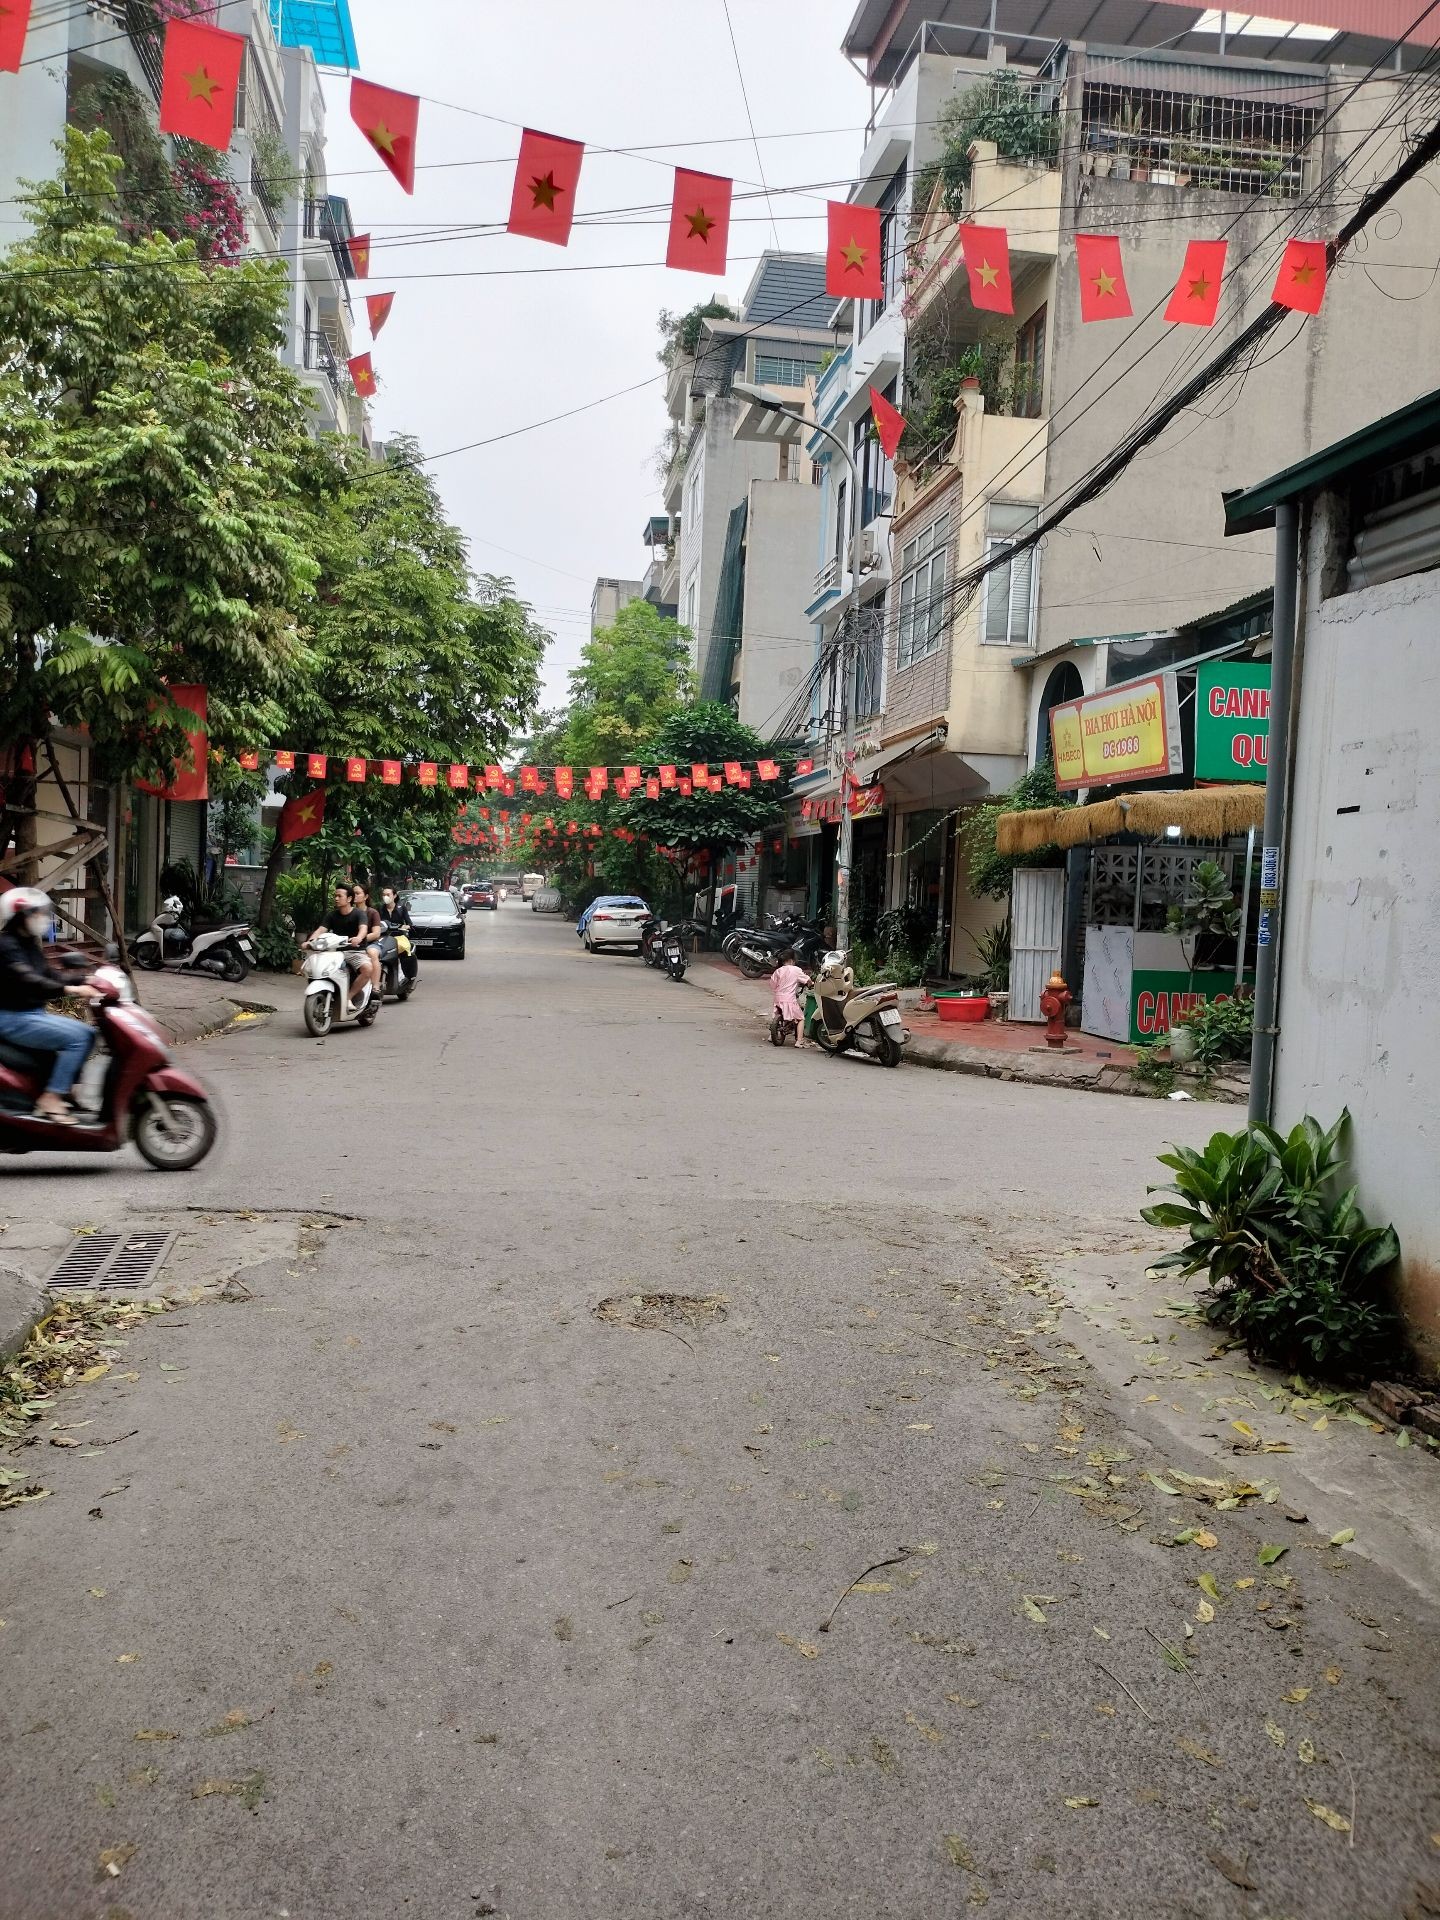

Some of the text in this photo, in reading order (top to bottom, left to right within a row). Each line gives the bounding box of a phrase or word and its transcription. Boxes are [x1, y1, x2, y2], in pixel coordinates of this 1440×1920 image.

[1084, 718, 1101, 736] BIA
[1119, 703, 1137, 727] HÀ
[1136, 698, 1158, 727] NỘI
[1115, 736, 1140, 757] 1988
